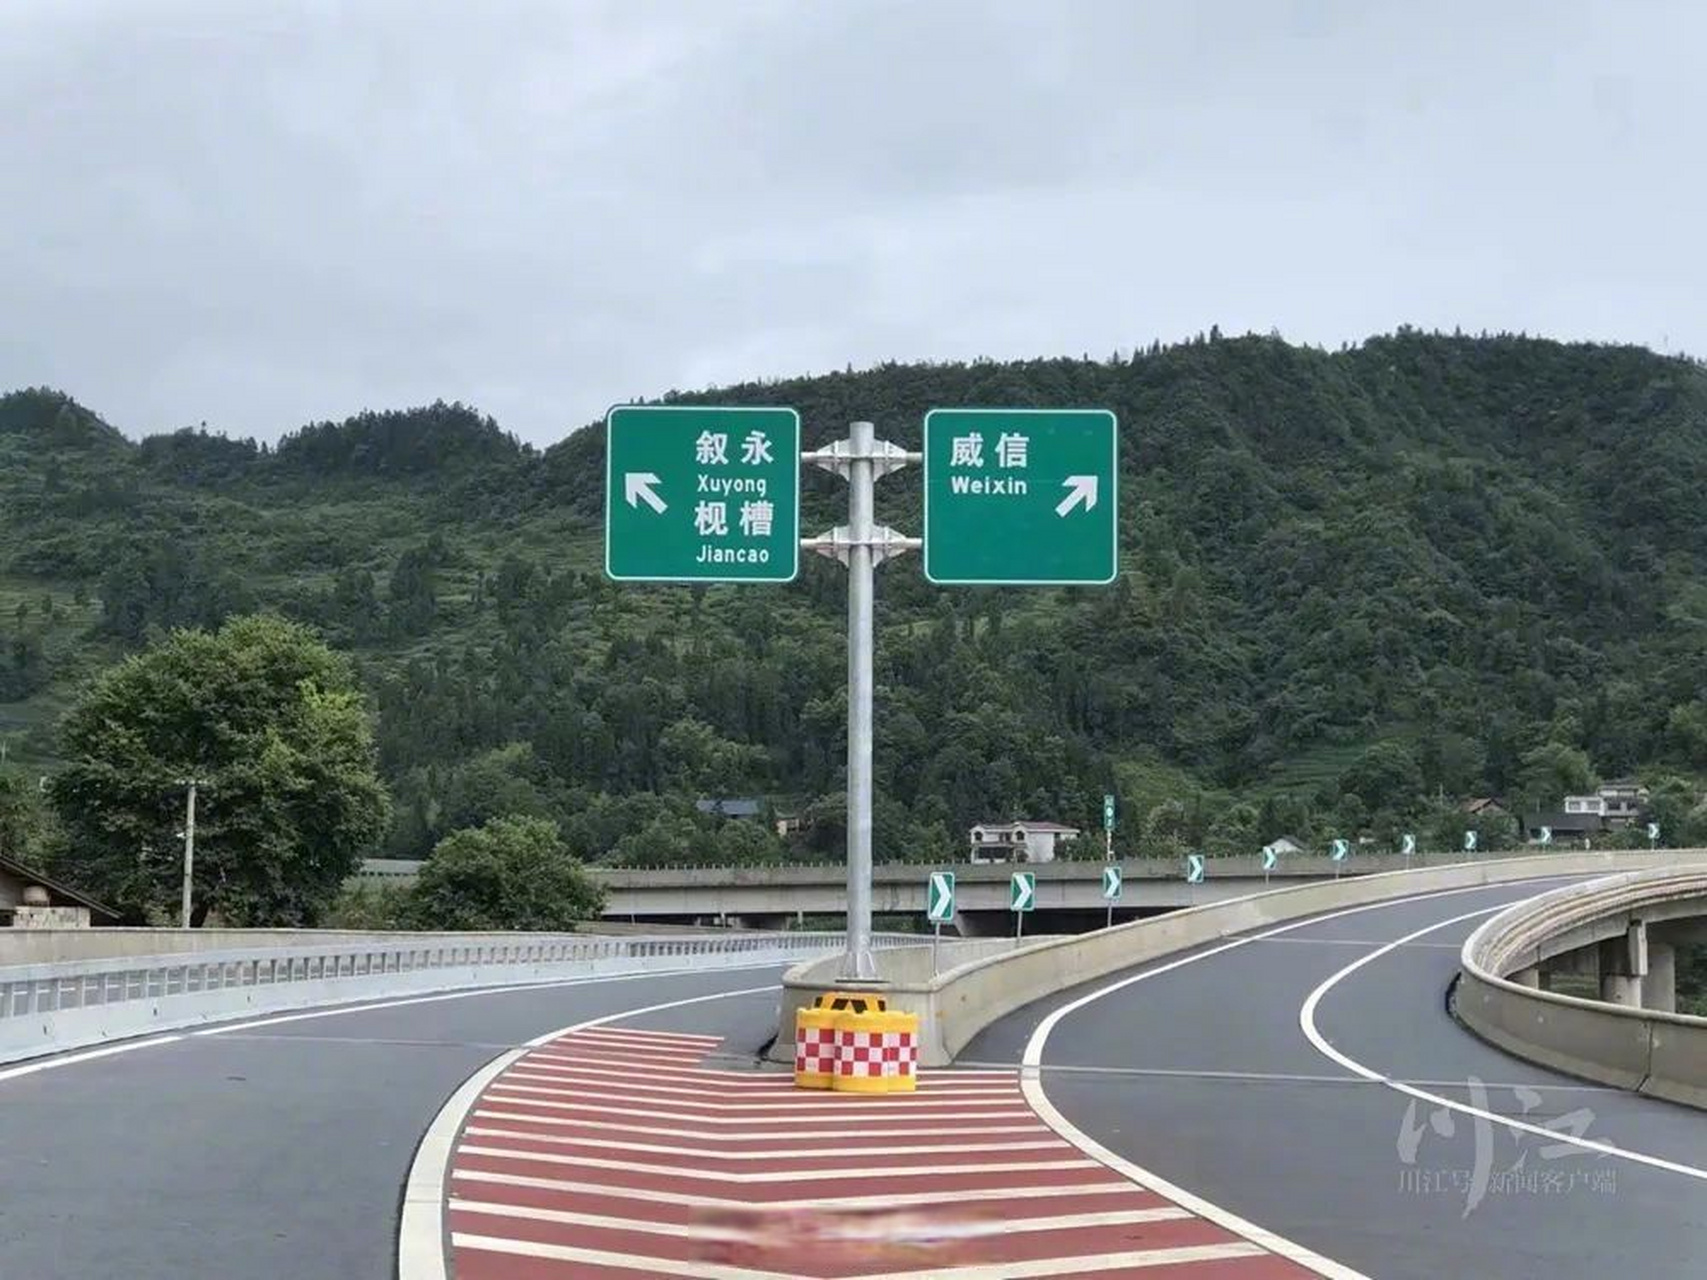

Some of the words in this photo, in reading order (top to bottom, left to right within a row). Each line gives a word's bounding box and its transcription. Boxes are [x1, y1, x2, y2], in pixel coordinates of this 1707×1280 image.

[695, 430, 774, 465] 叙永
[950, 432, 1030, 468] 威信
[697, 474, 767, 498] Xuyong
[951, 476, 1028, 495] Weixin
[694, 500, 774, 536] 枧槽
[696, 545, 770, 563] Jiancao
